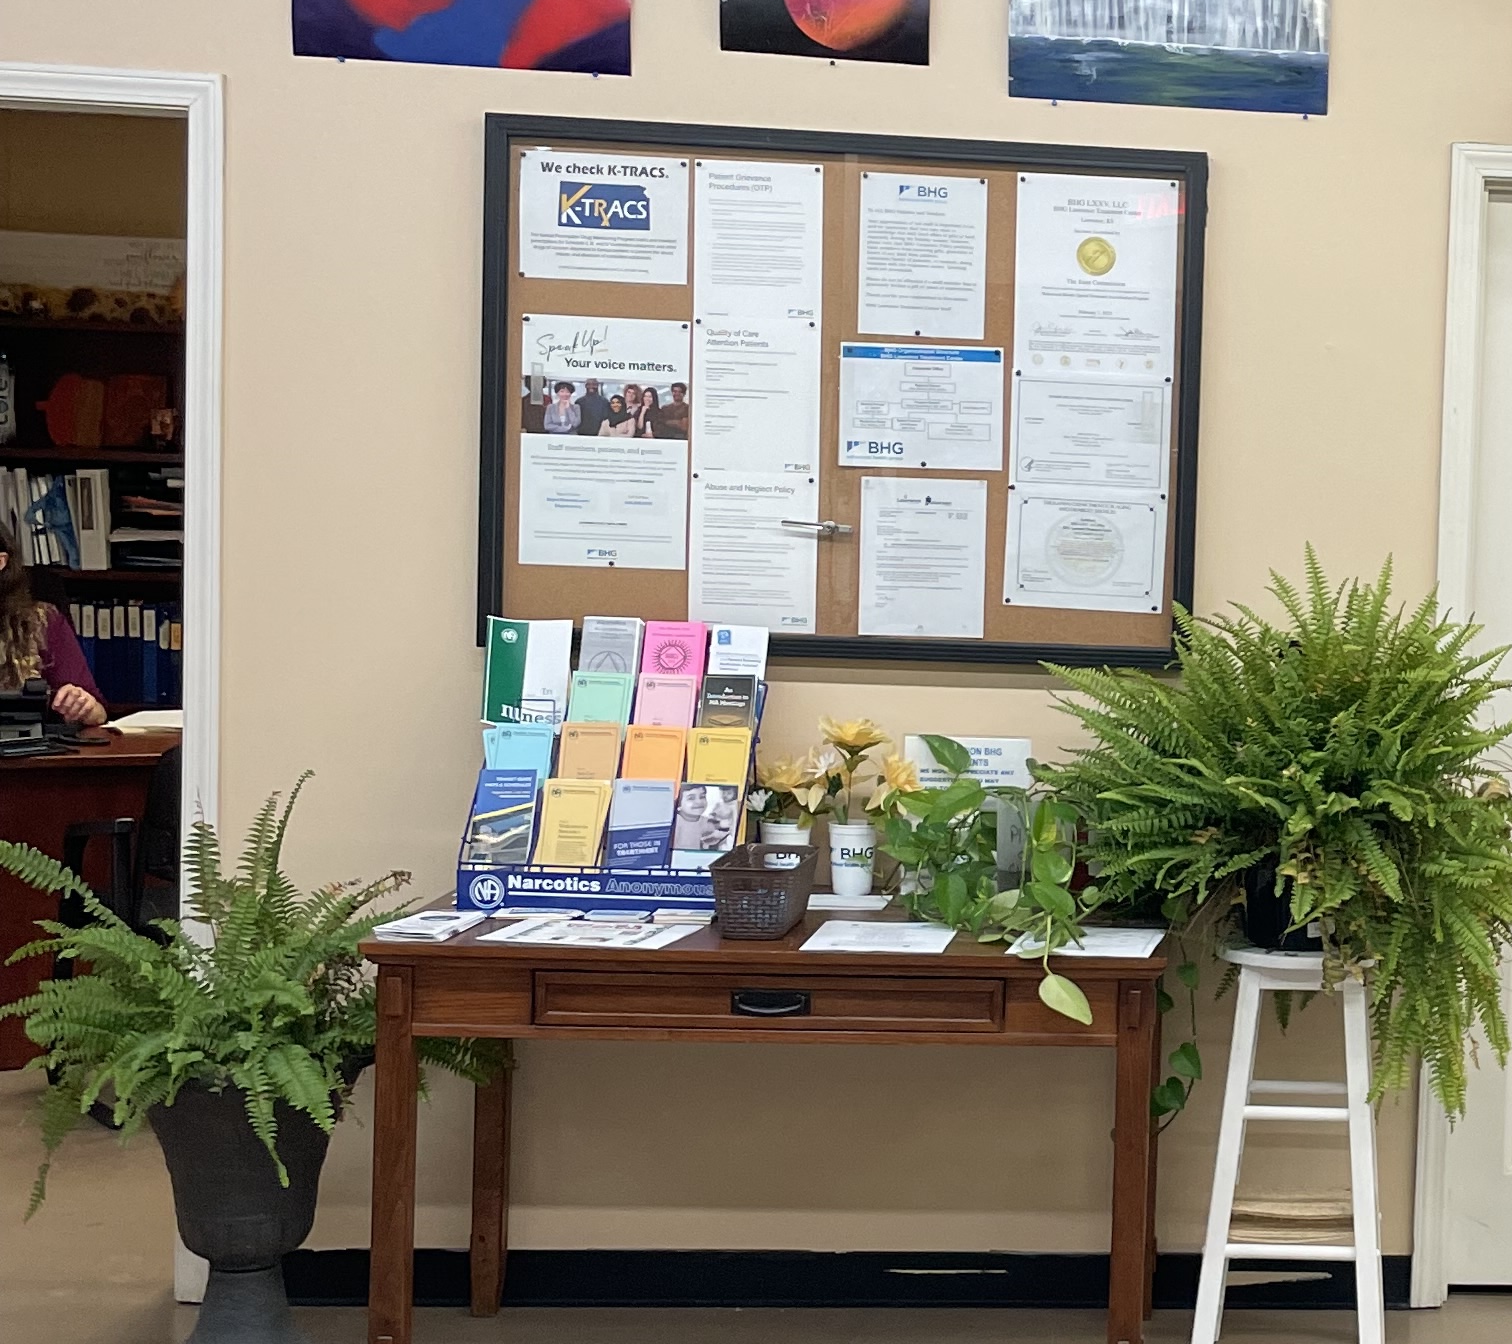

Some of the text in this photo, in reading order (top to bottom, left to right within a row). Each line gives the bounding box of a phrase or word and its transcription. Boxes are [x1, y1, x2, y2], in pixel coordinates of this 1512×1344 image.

[540, 161, 562, 173] We
[565, 163, 604, 176] check
[917, 186, 948, 198] BHG
[706, 328, 759, 338] Quality of Care
[536, 324, 609, 362] Speak Up!
[706, 339, 769, 348] Attention Patients
[564, 357, 678, 373] Your voice matters.
[868, 441, 904, 455] BHG
[704, 483, 796, 495] Abuse and Neglect Policy
[984, 747, 1003, 757] BHG
[613, 842, 629, 850] FOR
[629, 841, 652, 849] THOSE
[840, 846, 874, 860] BHG
[507, 874, 714, 898] Narcotics Anonymous
